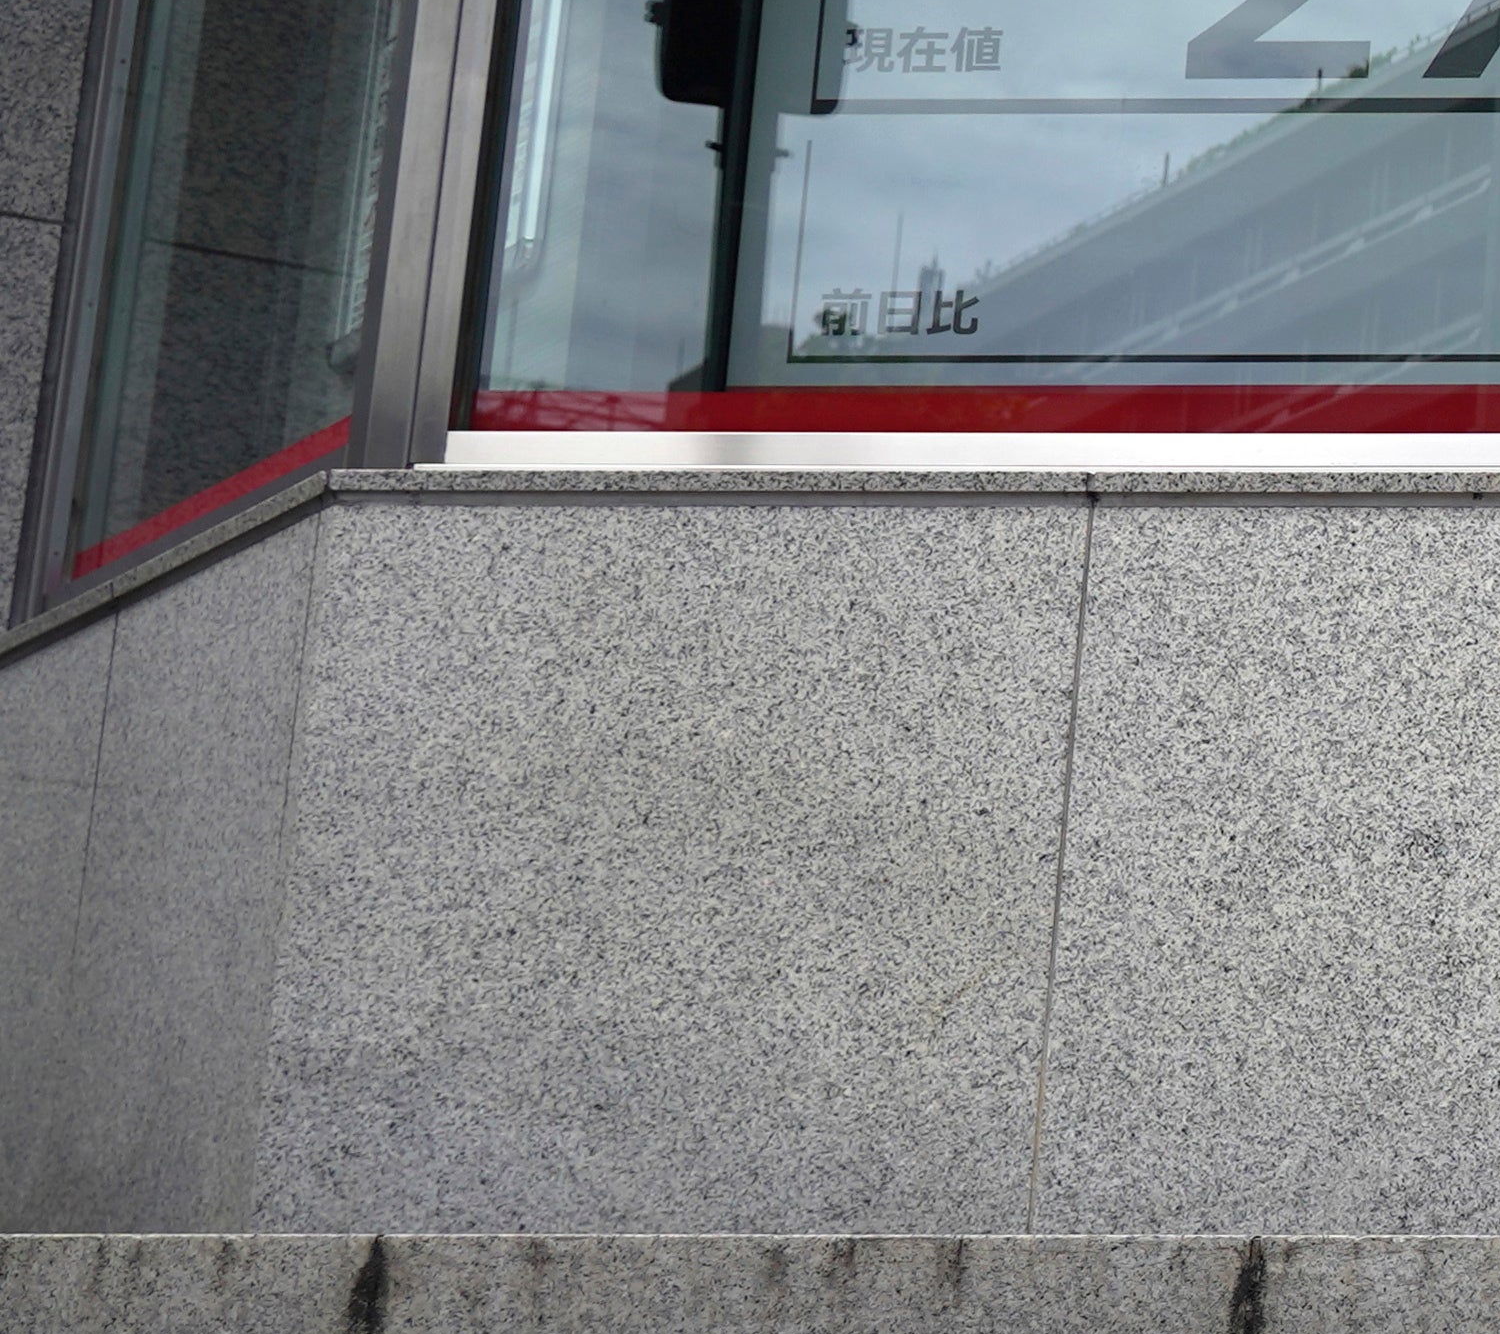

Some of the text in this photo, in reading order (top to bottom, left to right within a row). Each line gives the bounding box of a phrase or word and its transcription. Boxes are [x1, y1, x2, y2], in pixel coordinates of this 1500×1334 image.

[846, 26, 1004, 73] 現在値
[822, 288, 980, 335] 前日比
